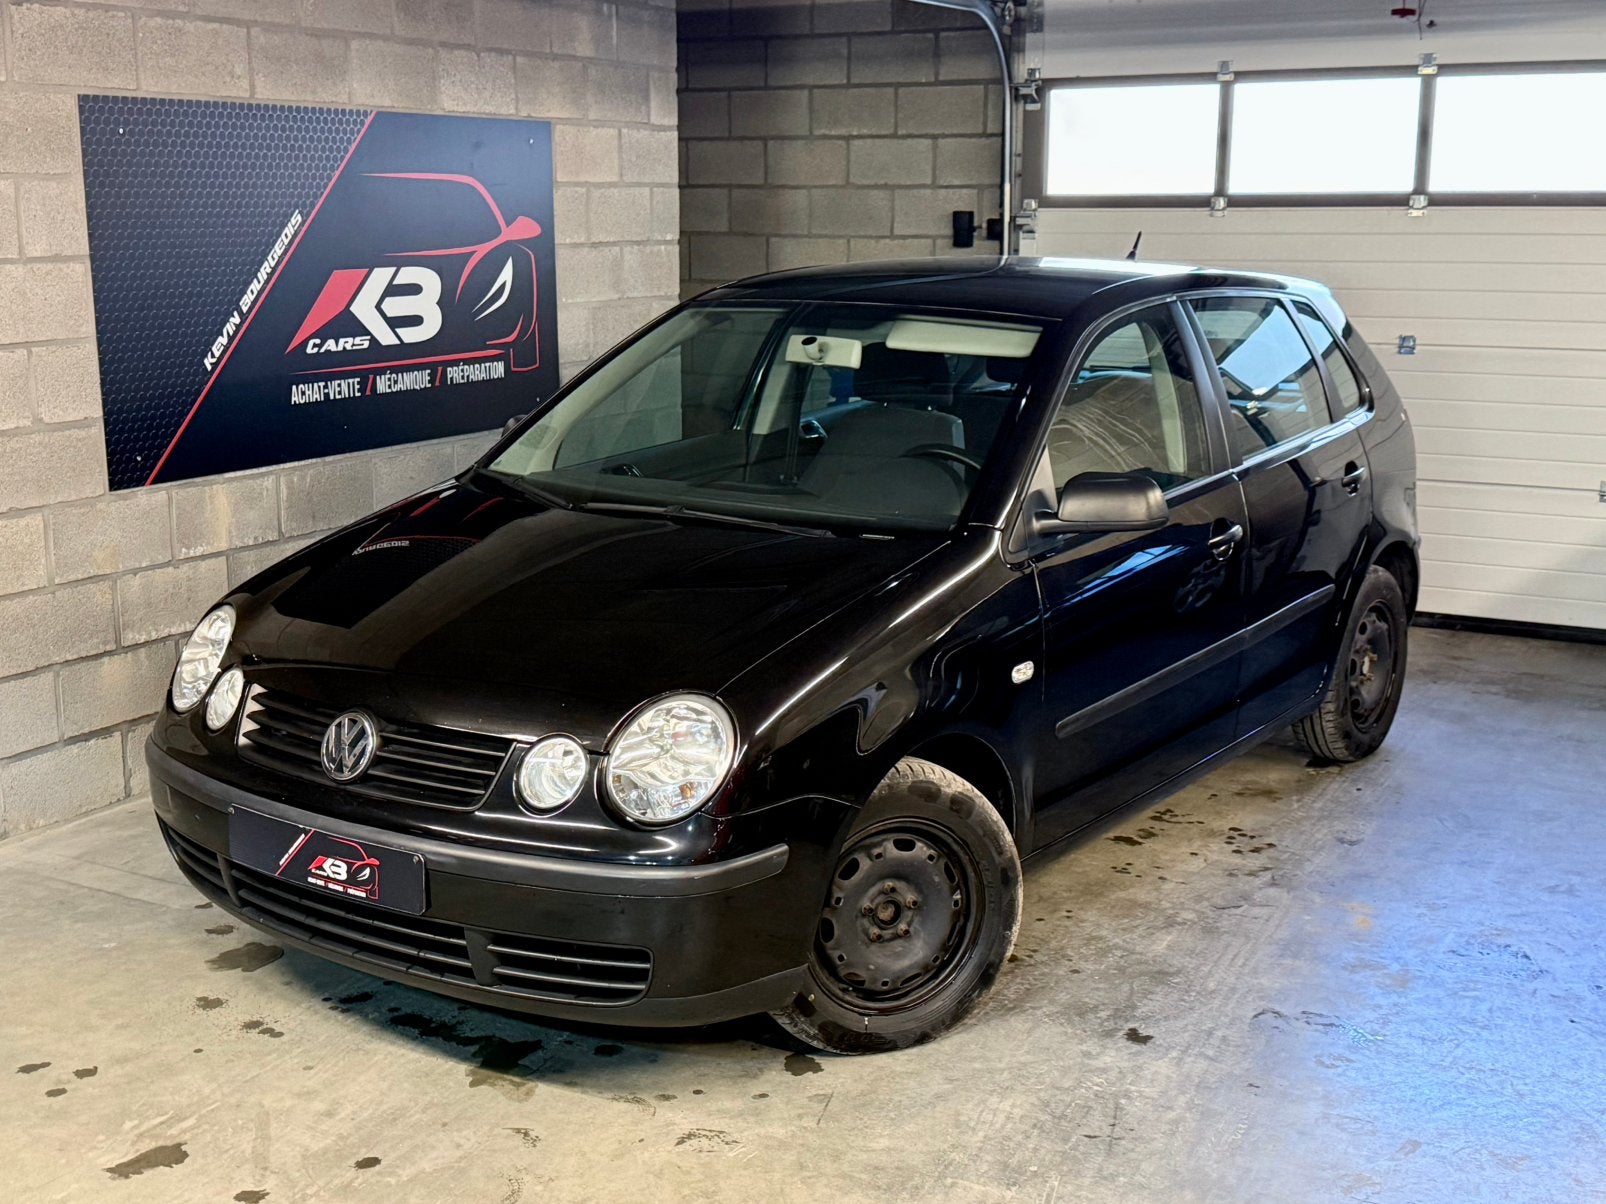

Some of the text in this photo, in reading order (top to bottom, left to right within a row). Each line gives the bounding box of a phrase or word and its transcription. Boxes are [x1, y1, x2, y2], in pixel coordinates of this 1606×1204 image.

[203, 209, 303, 371] KEVIN BOURGEOIS
[285, 266, 442, 352] KB
[306, 335, 371, 354] CARS
[291, 377, 361, 405] ACHAT-VENTE
[376, 369, 431, 395] MÉCANIQUE
[446, 360, 505, 385] PRÉPARATION
